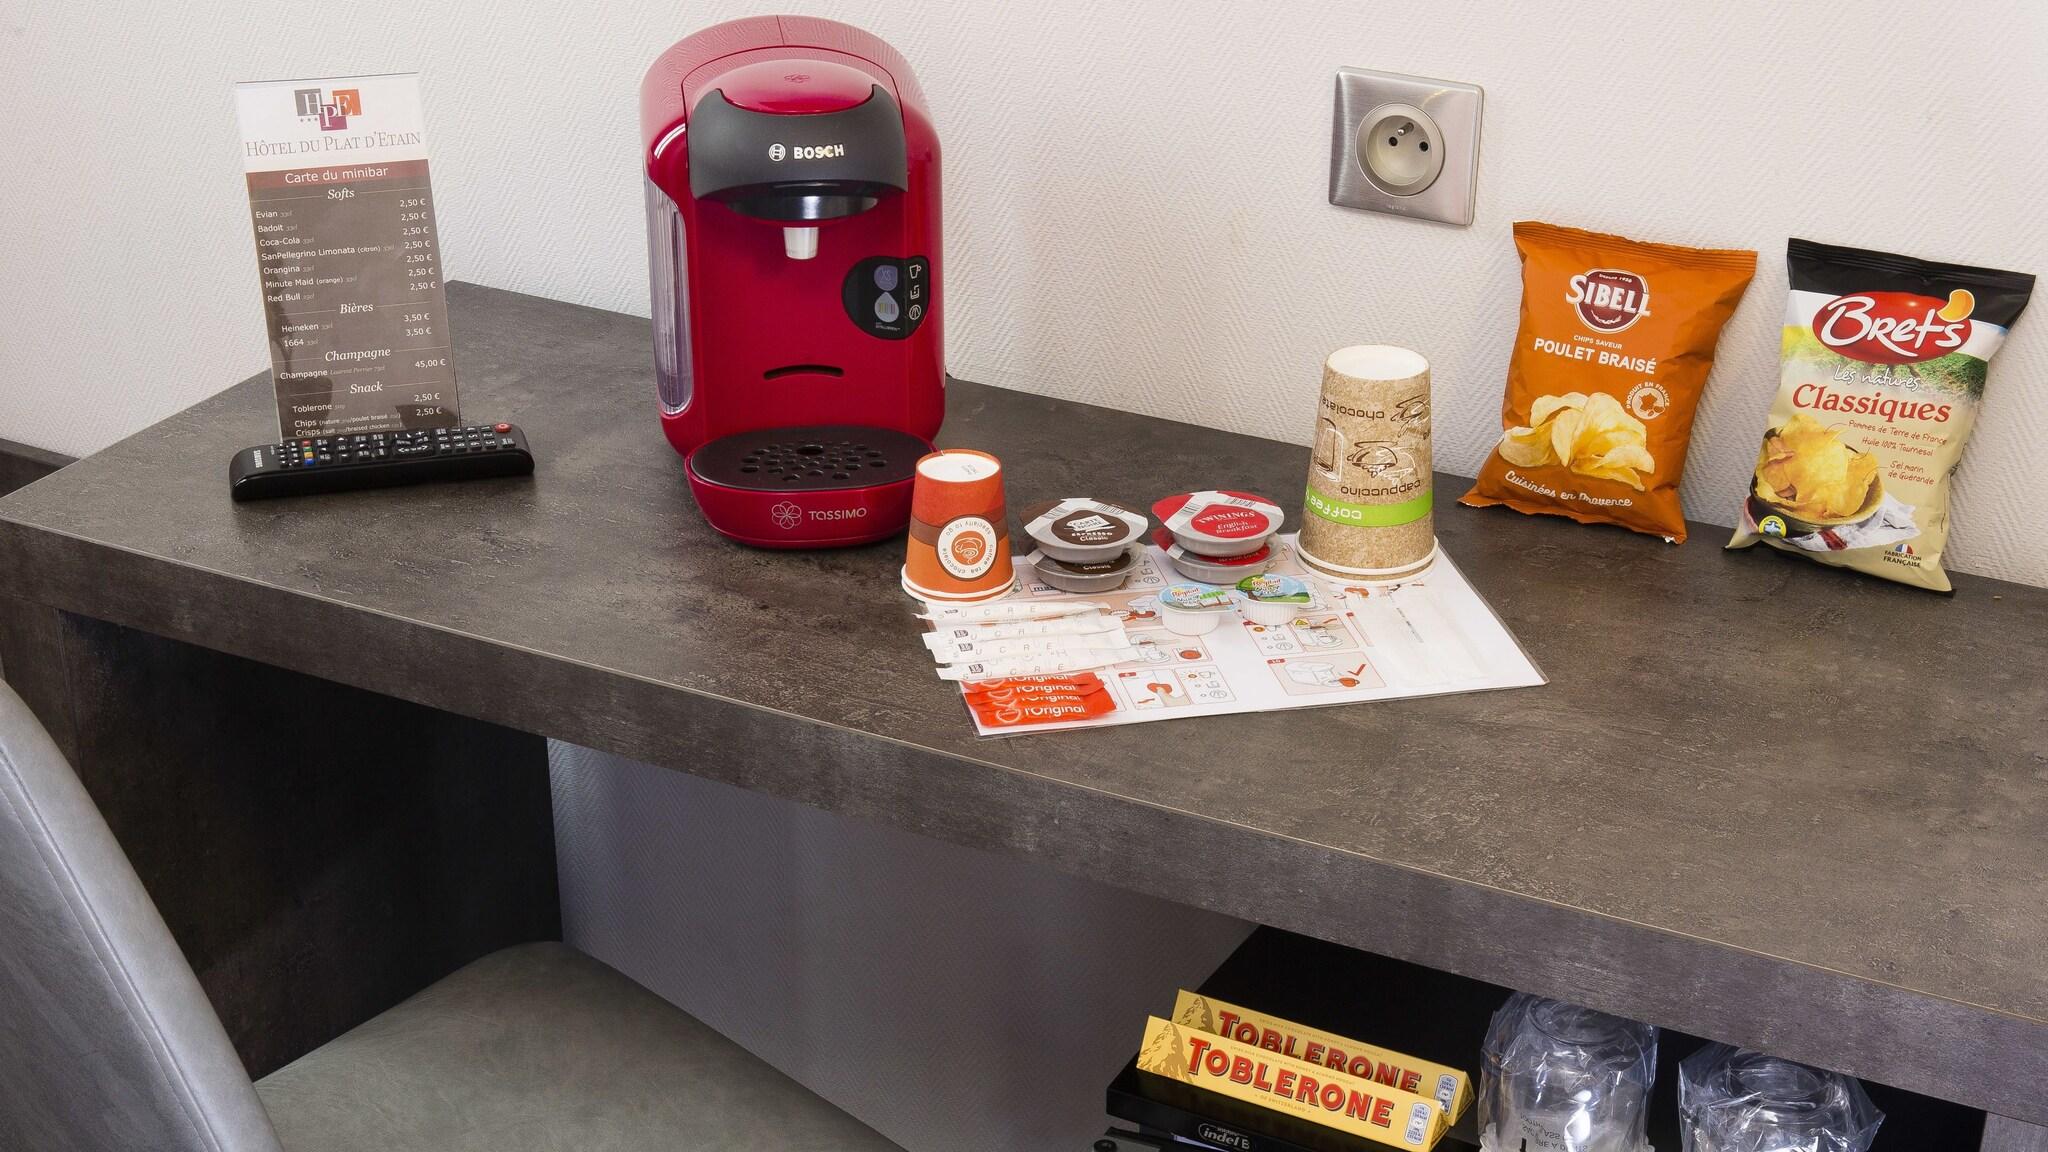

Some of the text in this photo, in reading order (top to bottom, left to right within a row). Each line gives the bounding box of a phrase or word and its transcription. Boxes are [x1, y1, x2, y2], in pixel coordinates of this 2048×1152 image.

[246, 137, 297, 158] HÔTEL
[300, 140, 320, 155] DU
[324, 135, 361, 152] PLAT
[793, 144, 845, 160] BOSCH
[285, 165, 389, 184] Carte du minibar
[328, 187, 355, 201] Softs
[400, 198, 427, 208] 2,50 €
[255, 211, 278, 219] Evian
[401, 212, 428, 222] 2,50 €
[258, 224, 284, 233] Badoit
[403, 226, 430, 236] 2,50 €
[260, 237, 301, 247] Coca-Cola
[405, 240, 431, 249] 2,50 €
[262, 249, 316, 261] SanPellegrino
[318, 246, 355, 256] Limonata
[406, 255, 425, 264] 2,50
[264, 266, 301, 275] Orangina
[408, 267, 435, 277] 2,50 €
[266, 280, 293, 289] Minute
[295, 278, 314, 286] Maid
[316, 277, 344, 286] (orange)
[410, 281, 437, 291] 2,50 €
[268, 294, 283, 303] Red
[285, 293, 301, 301] Bull
[1565, 274, 1652, 317] SIBELL
[340, 302, 374, 314] Bières
[404, 312, 431, 323] 3,50 €
[281, 323, 319, 333] Heineken
[405, 327, 432, 337] 3,50 €
[284, 338, 304, 347] 1664
[1573, 335, 1623, 350] CHIPS SAVEUR
[325, 348, 391, 363] Champagne
[1534, 337, 1657, 375] POULET BRAISÉ
[414, 358, 446, 369] 45,00 €
[280, 369, 328, 380] Champagne
[1833, 364, 1920, 392] Les natures
[350, 381, 383, 394] Snack
[414, 392, 440, 403] 2,50 €
[1626, 383, 1643, 409] PRODUIT
[1655, 383, 1670, 407] FRANCE
[1322, 396, 1385, 419] chocolate
[1792, 382, 1952, 423] Classiques
[292, 404, 333, 414] Toblerone
[416, 406, 442, 417] 2,50 €
[294, 419, 317, 429] Chips
[296, 428, 321, 438] Crisps
[1848, 419, 1947, 446] Pommes de Terre de France
[1862, 436, 1934, 457] Huile 100% Tournesol
[1890, 460, 1924, 474] Sel marin
[1888, 470, 1898, 479] de
[1340, 480, 1421, 497] cappuccino
[1505, 470, 1633, 507] Cuisinées en Provence
[1310, 494, 1362, 520] coffee
[808, 507, 867, 521] TASSIMO
[1195, 511, 1256, 524] TWININGS
[1217, 520, 1248, 531] English
[1884, 550, 1922, 561] FABRICATION
[1883, 555, 1921, 569] FRANÇAISE
[1016, 684, 1077, 694] l'Original
[1024, 704, 1086, 717] l'Original
[1219, 1010, 1423, 1094] TOBLERONE
[1188, 1036, 1395, 1129] TOBLERONE
[1203, 1127, 1240, 1146] indel
[1241, 1138, 1250, 1150] B
